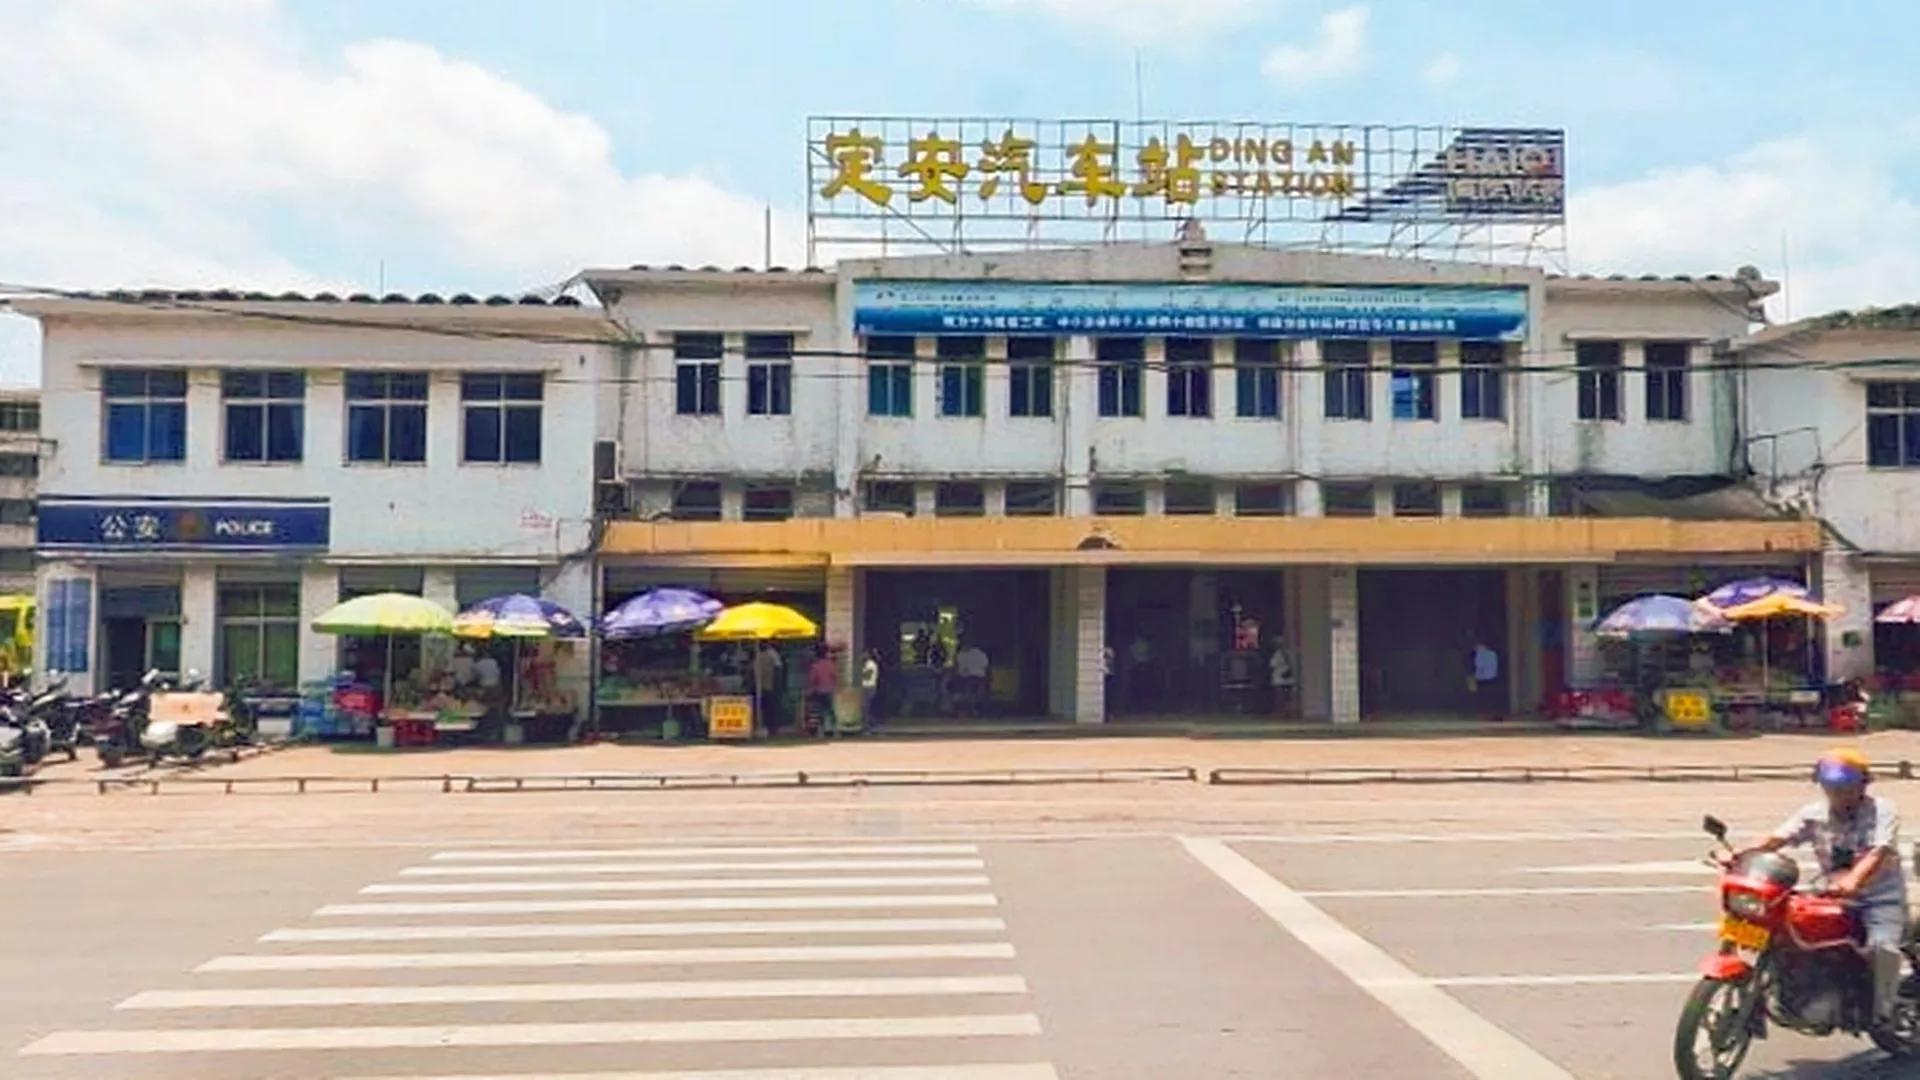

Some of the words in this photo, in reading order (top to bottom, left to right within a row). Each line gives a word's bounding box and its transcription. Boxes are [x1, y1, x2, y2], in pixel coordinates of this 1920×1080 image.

[1210, 138, 1292, 164] DING
[1307, 140, 1354, 165] AN
[820, 128, 1204, 206] 定安汽车站
[1211, 170, 1353, 196] STATION
[100, 515, 161, 540] 公安
[215, 519, 273, 536] POLICE
